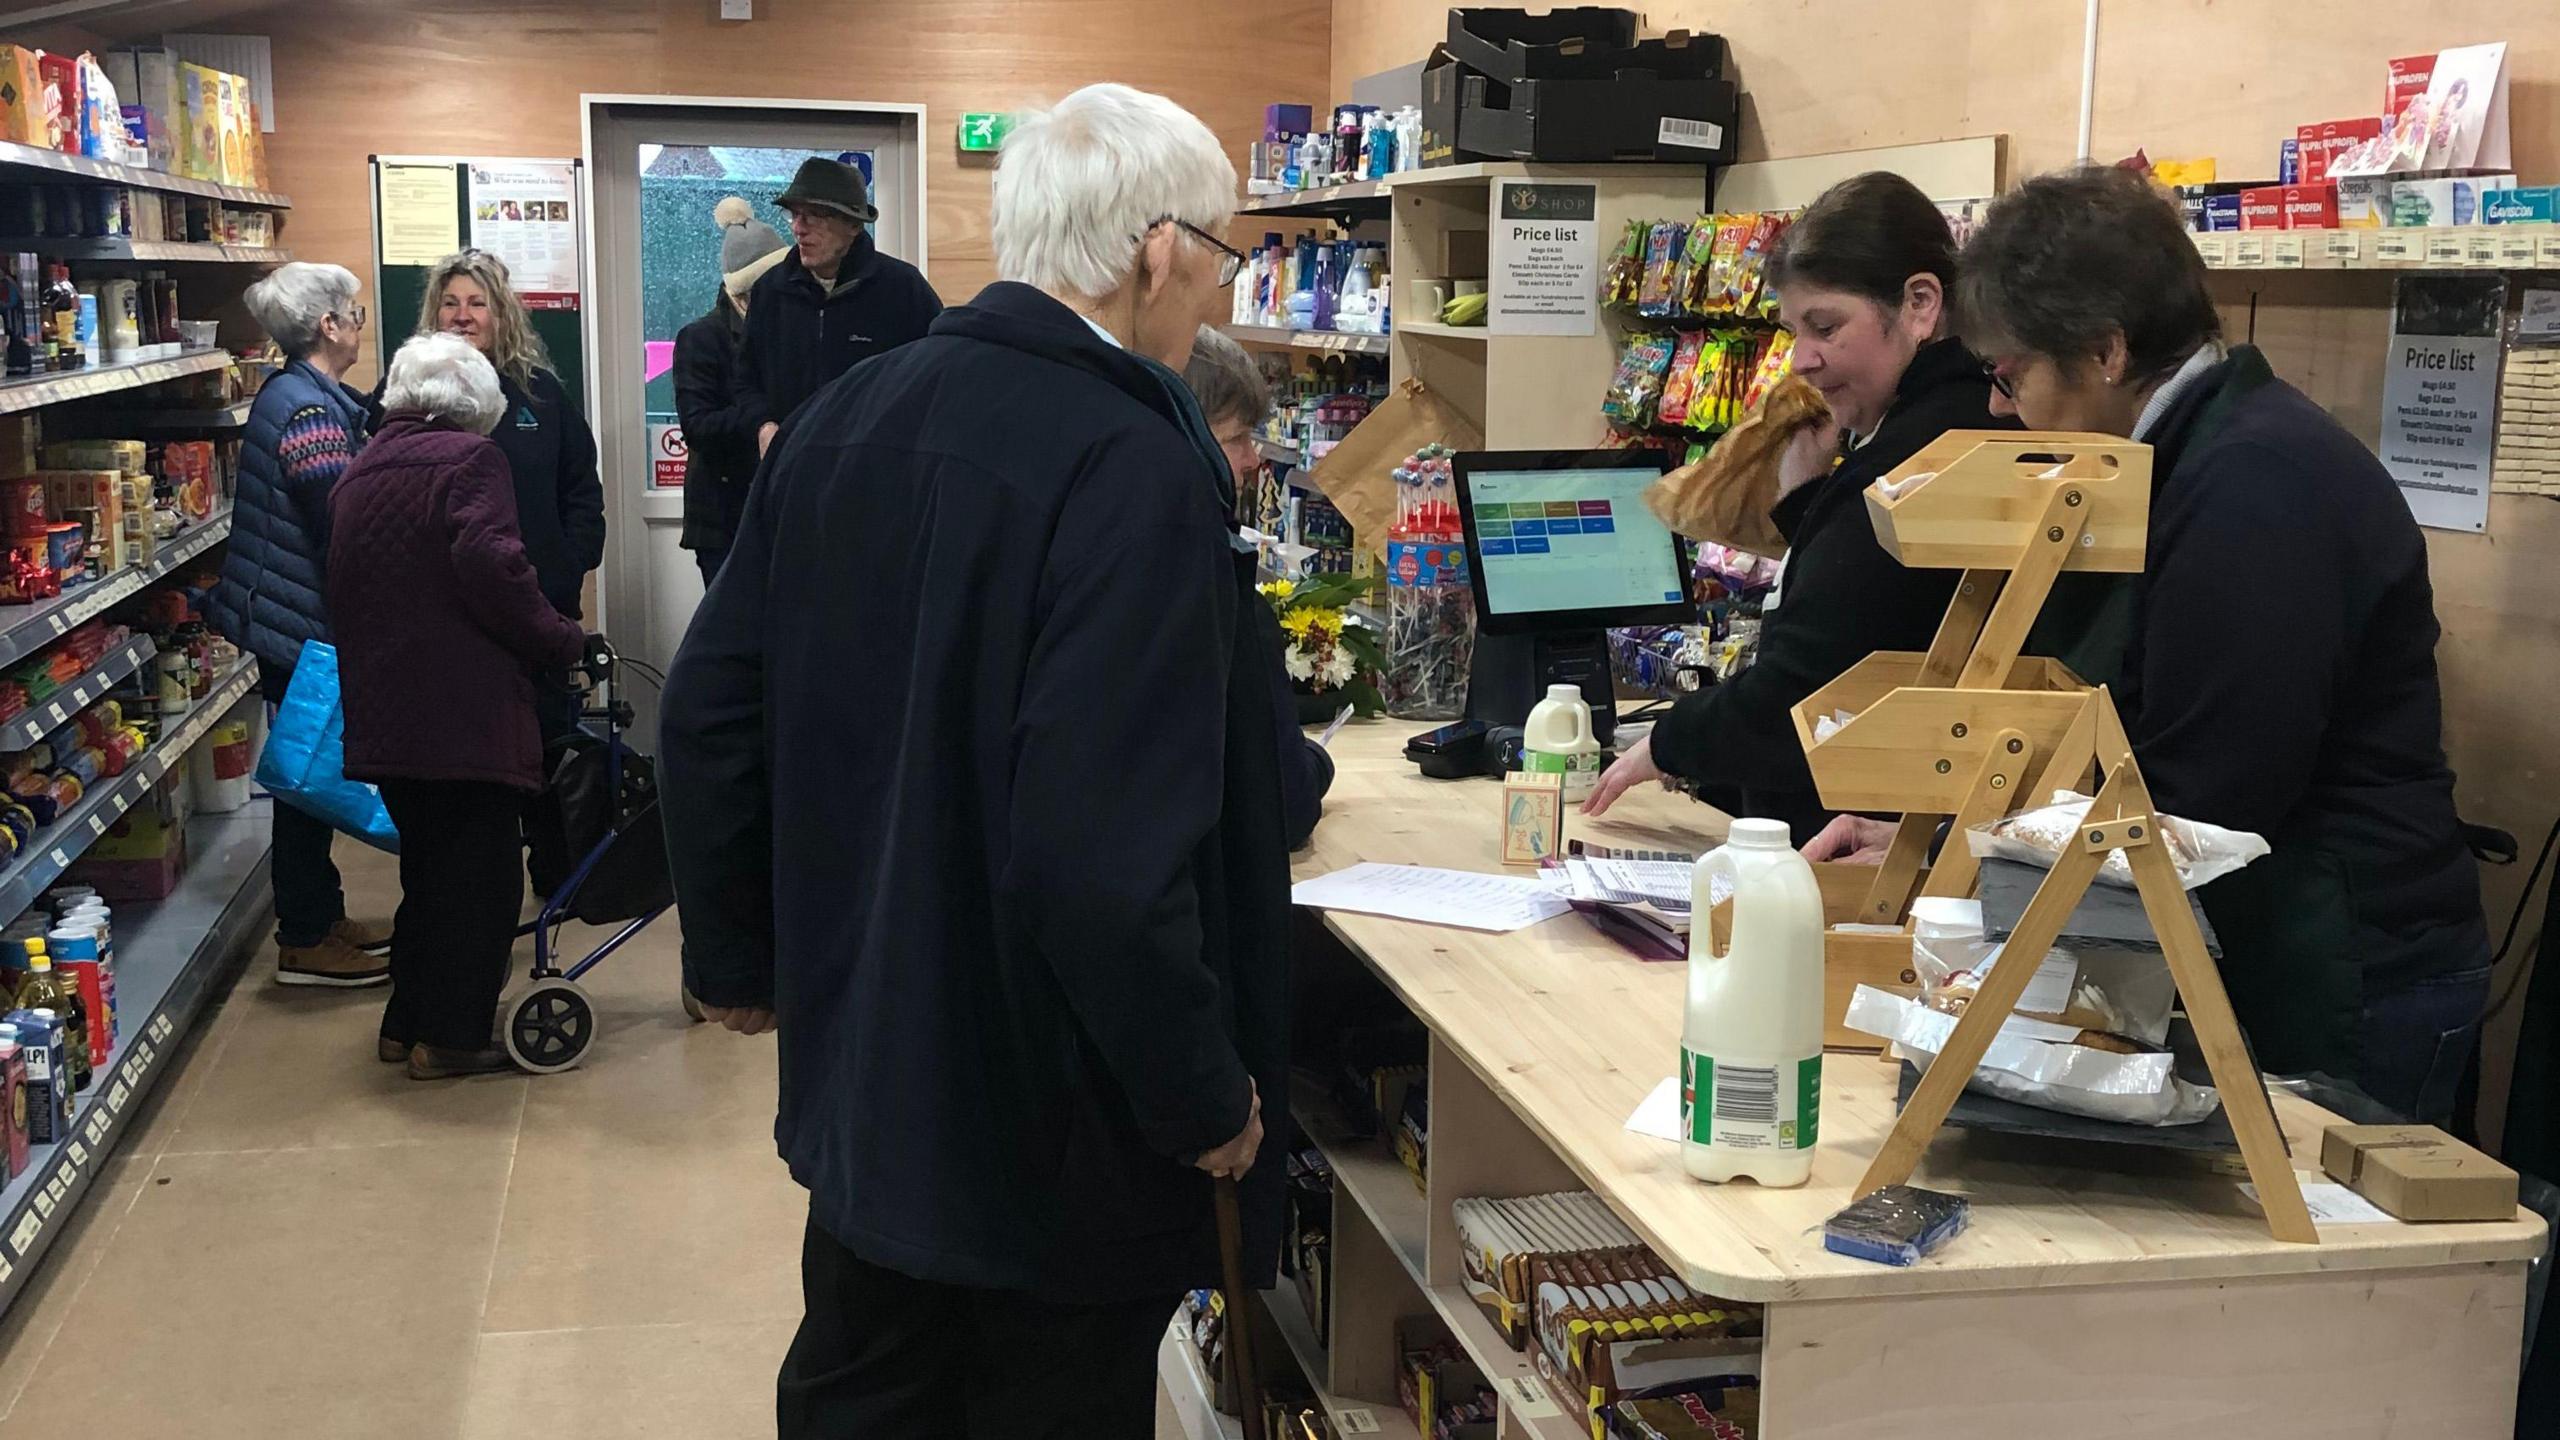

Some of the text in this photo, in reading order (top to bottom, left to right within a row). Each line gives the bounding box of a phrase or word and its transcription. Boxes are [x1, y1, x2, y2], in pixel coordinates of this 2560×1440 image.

[2340, 181, 2372, 197] Strepsils
[1540, 199, 1586, 210] SHOP
[2242, 204, 2278, 216] IBUPROFEN
[2285, 202, 2322, 214] IBUPROFEN
[2490, 206, 2534, 218] GAVISCON
[1513, 227, 1578, 241] Price list
[2406, 348, 2475, 371] Price list
[658, 464, 687, 472] No do
